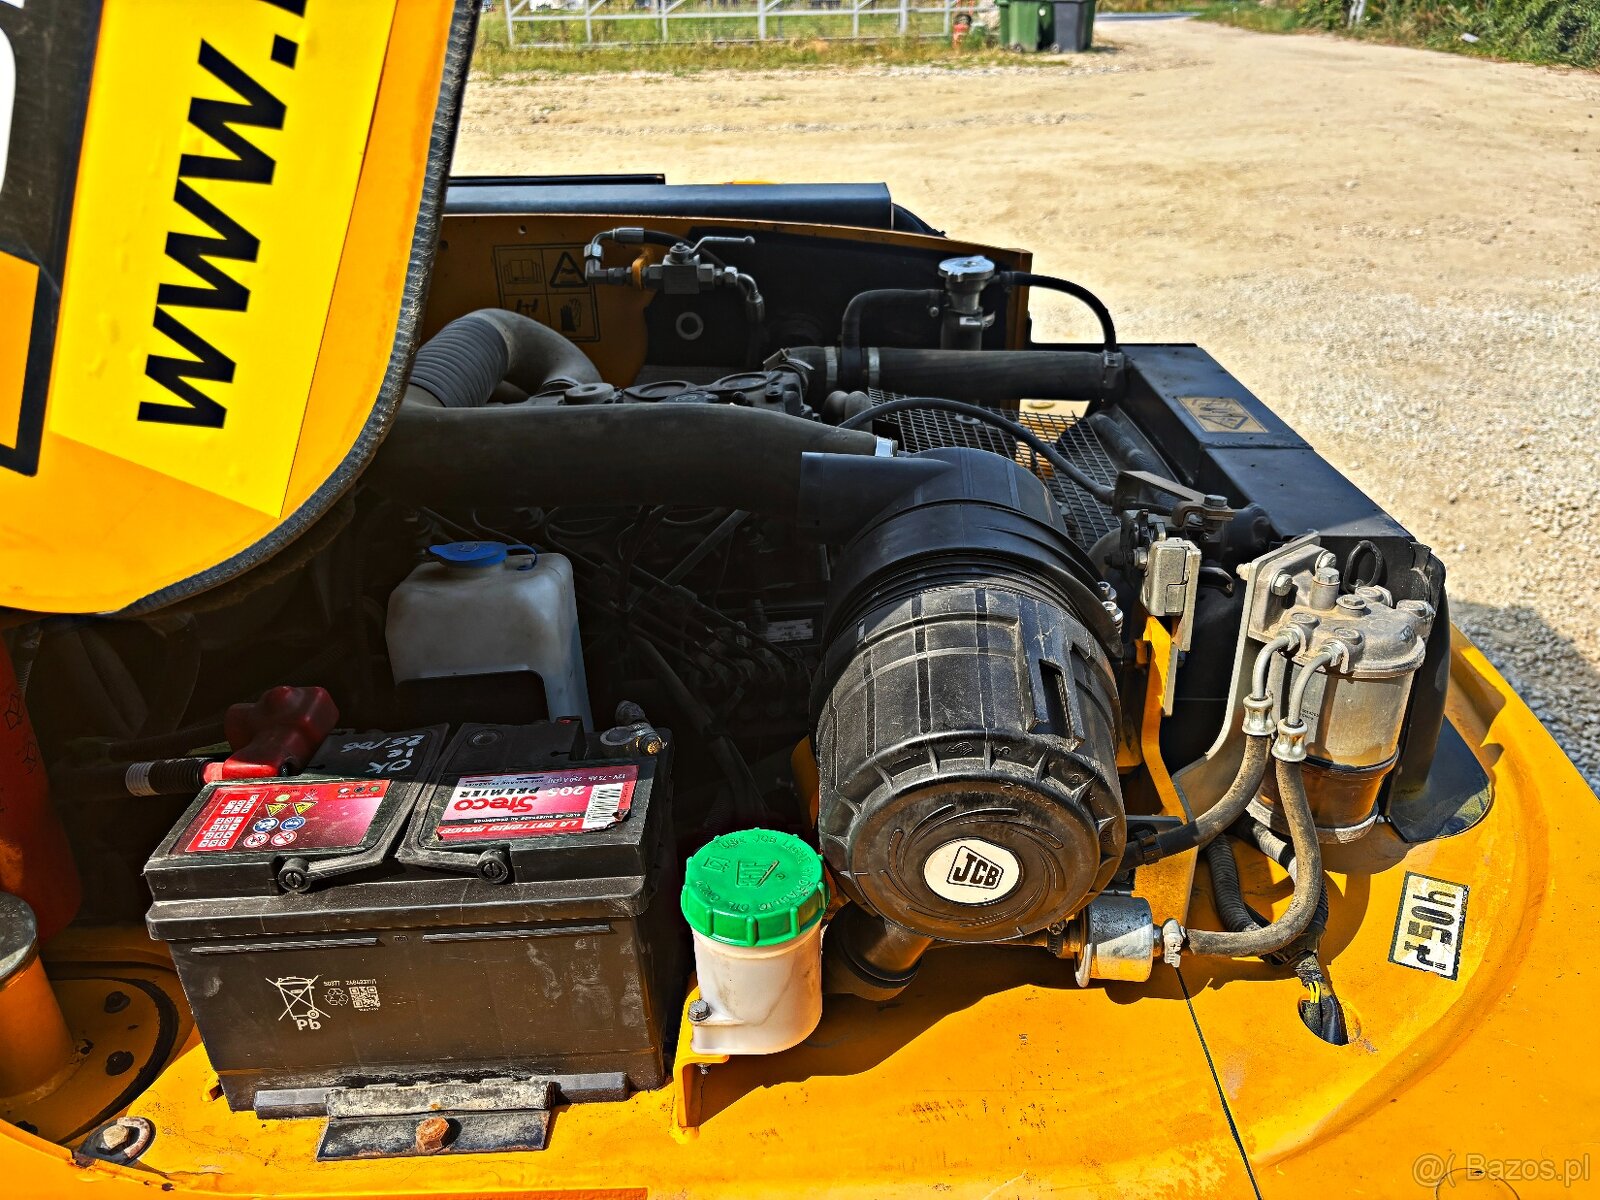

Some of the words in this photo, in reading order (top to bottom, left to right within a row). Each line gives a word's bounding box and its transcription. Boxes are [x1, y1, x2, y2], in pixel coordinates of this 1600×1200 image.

[137, 0, 307, 429] www.
[365, 759, 412, 774] OK
[459, 786, 541, 798] PREMIER
[453, 795, 538, 814] Steco
[558, 820, 579, 828] LA
[752, 833, 778, 844] JCB
[952, 852, 1000, 887] JCB
[295, 1018, 322, 1032] Pb
